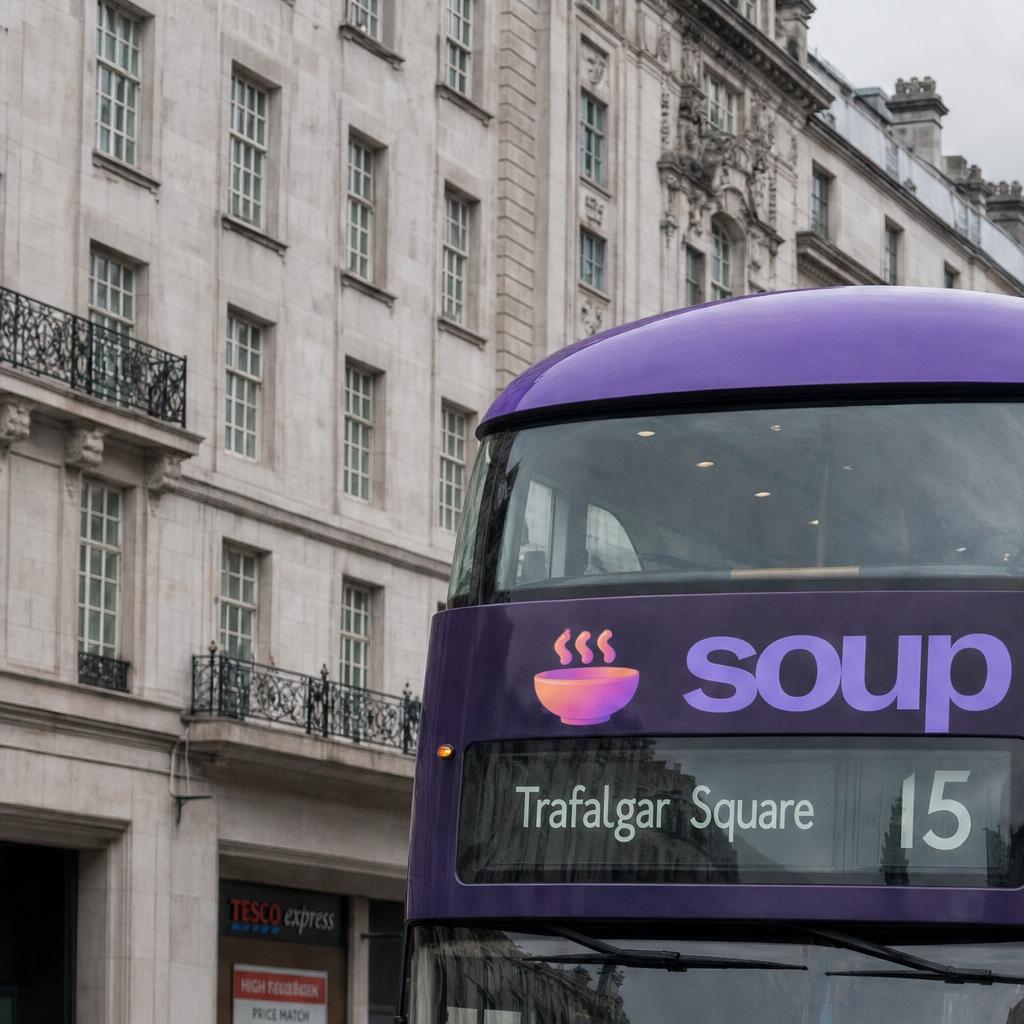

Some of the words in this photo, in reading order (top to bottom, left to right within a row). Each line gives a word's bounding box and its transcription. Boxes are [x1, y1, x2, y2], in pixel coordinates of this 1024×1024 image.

[683, 632, 1012, 733] soup
[516, 785, 670, 843] Trafalgar
[690, 785, 815, 843] Square
[901, 770, 973, 851] 15
[231, 899, 281, 925] TESCO
[284, 907, 335, 935] express
[252, 1007, 277, 1022] PRICE
[279, 1009, 310, 1023] MATCH
